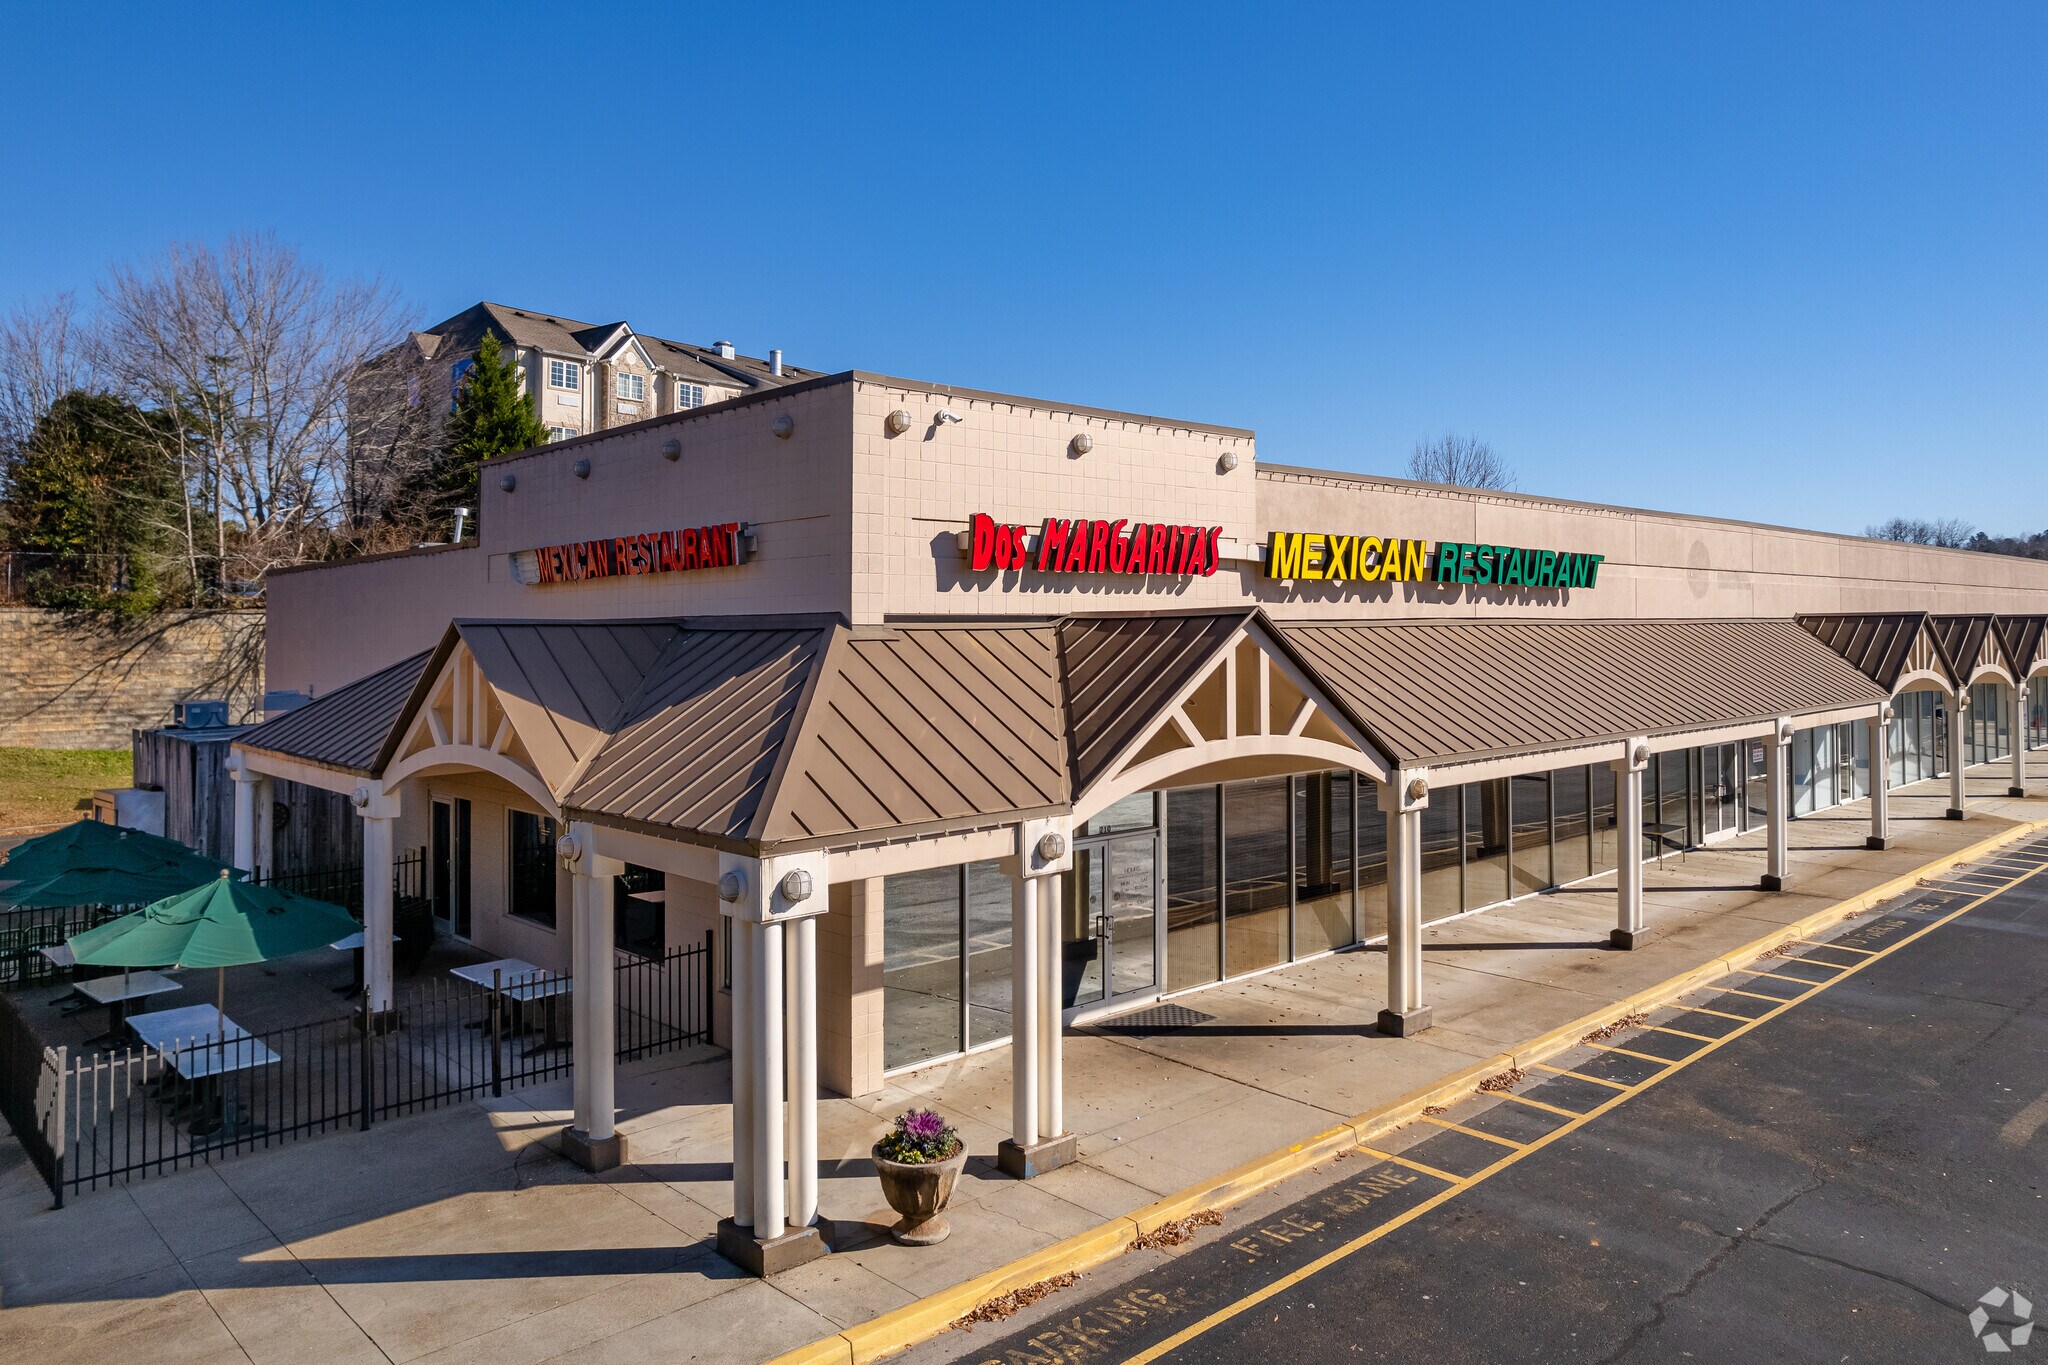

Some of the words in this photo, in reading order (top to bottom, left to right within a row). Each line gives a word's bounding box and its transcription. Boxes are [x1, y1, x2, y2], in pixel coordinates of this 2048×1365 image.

[538, 539, 609, 583] MEXICAN
[616, 522, 742, 576] RESTAURANT
[1037, 517, 1223, 577] MARGARITAS
[1270, 532, 1427, 582] MEXICAN
[1437, 542, 1605, 589] RESTAURANT
[1230, 1213, 1325, 1257] FIRE
